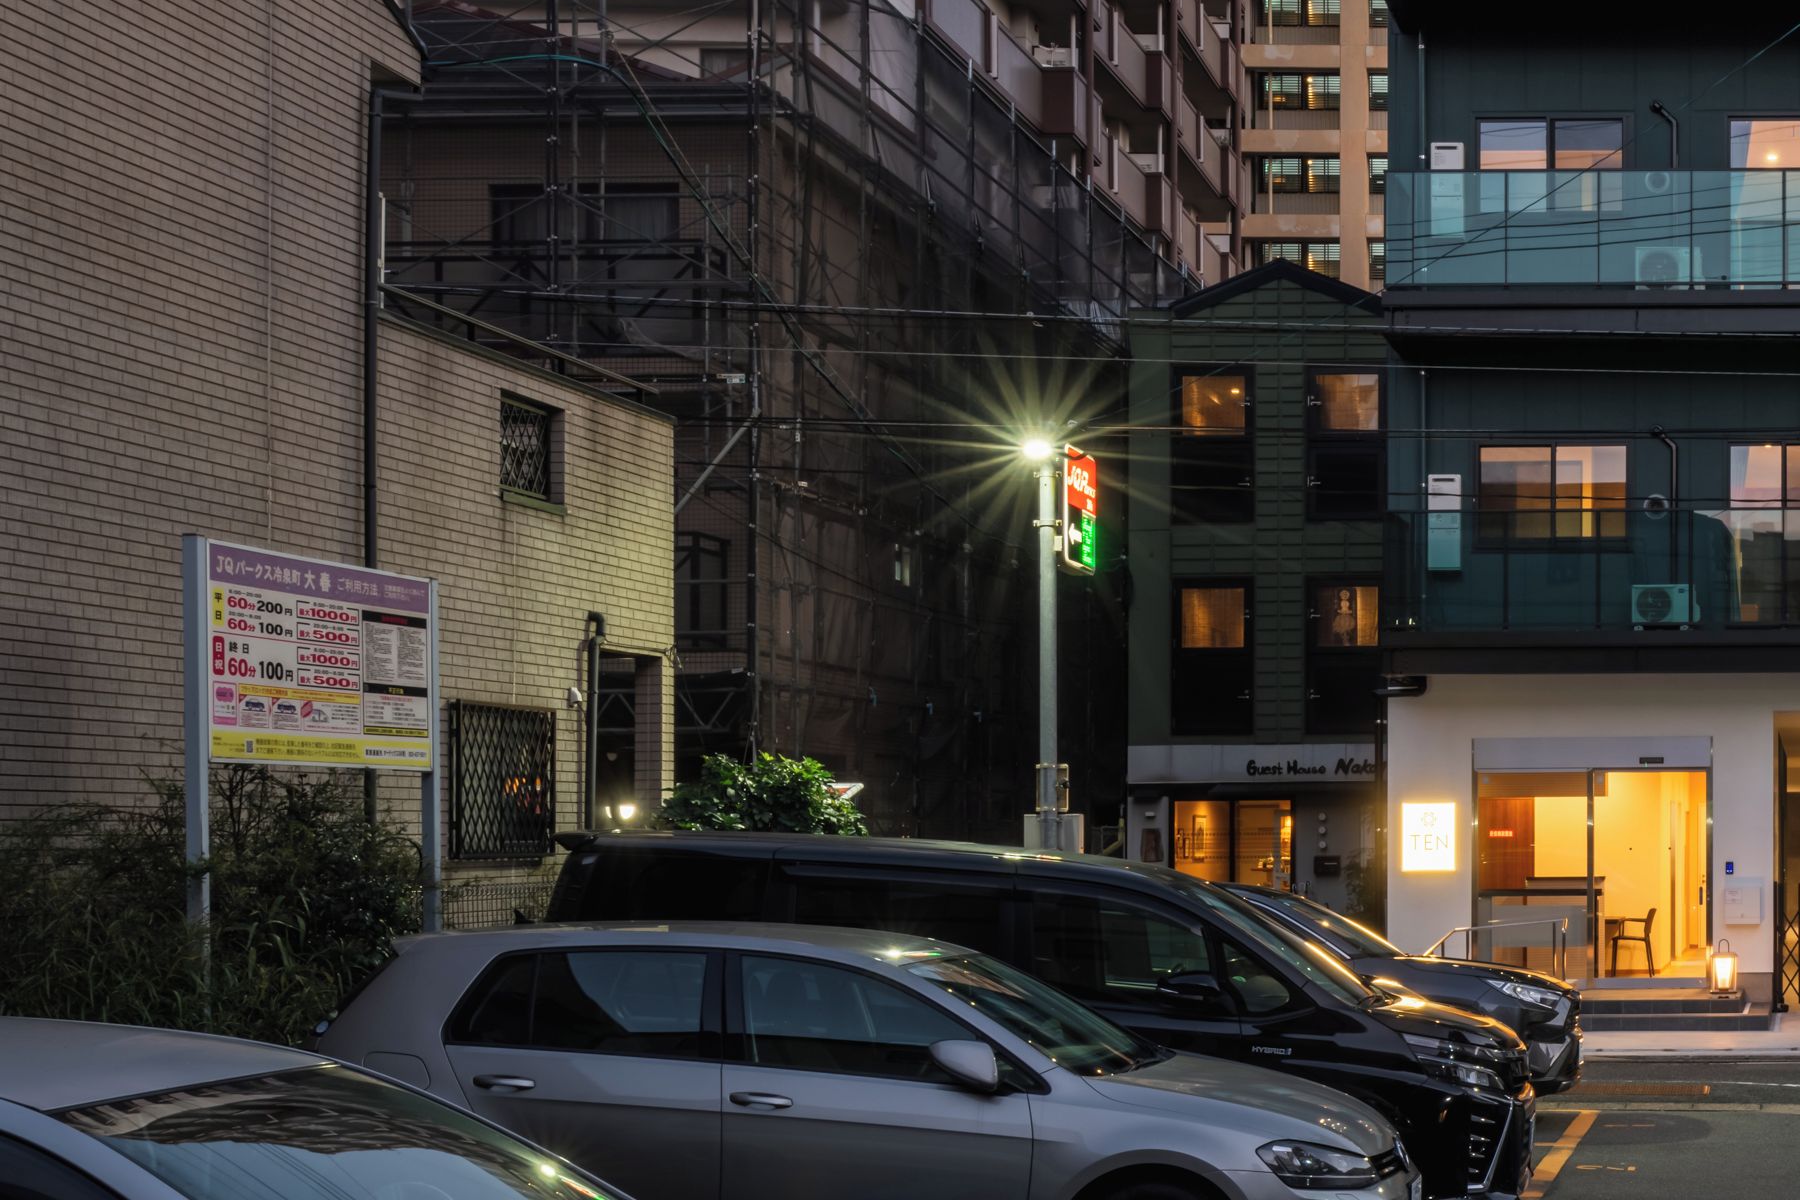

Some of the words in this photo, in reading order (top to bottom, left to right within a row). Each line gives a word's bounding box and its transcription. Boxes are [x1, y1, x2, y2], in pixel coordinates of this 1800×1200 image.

[1246, 759, 1283, 776] Guest
[1287, 759, 1326, 775] House
[1409, 834, 1448, 851] TEN
